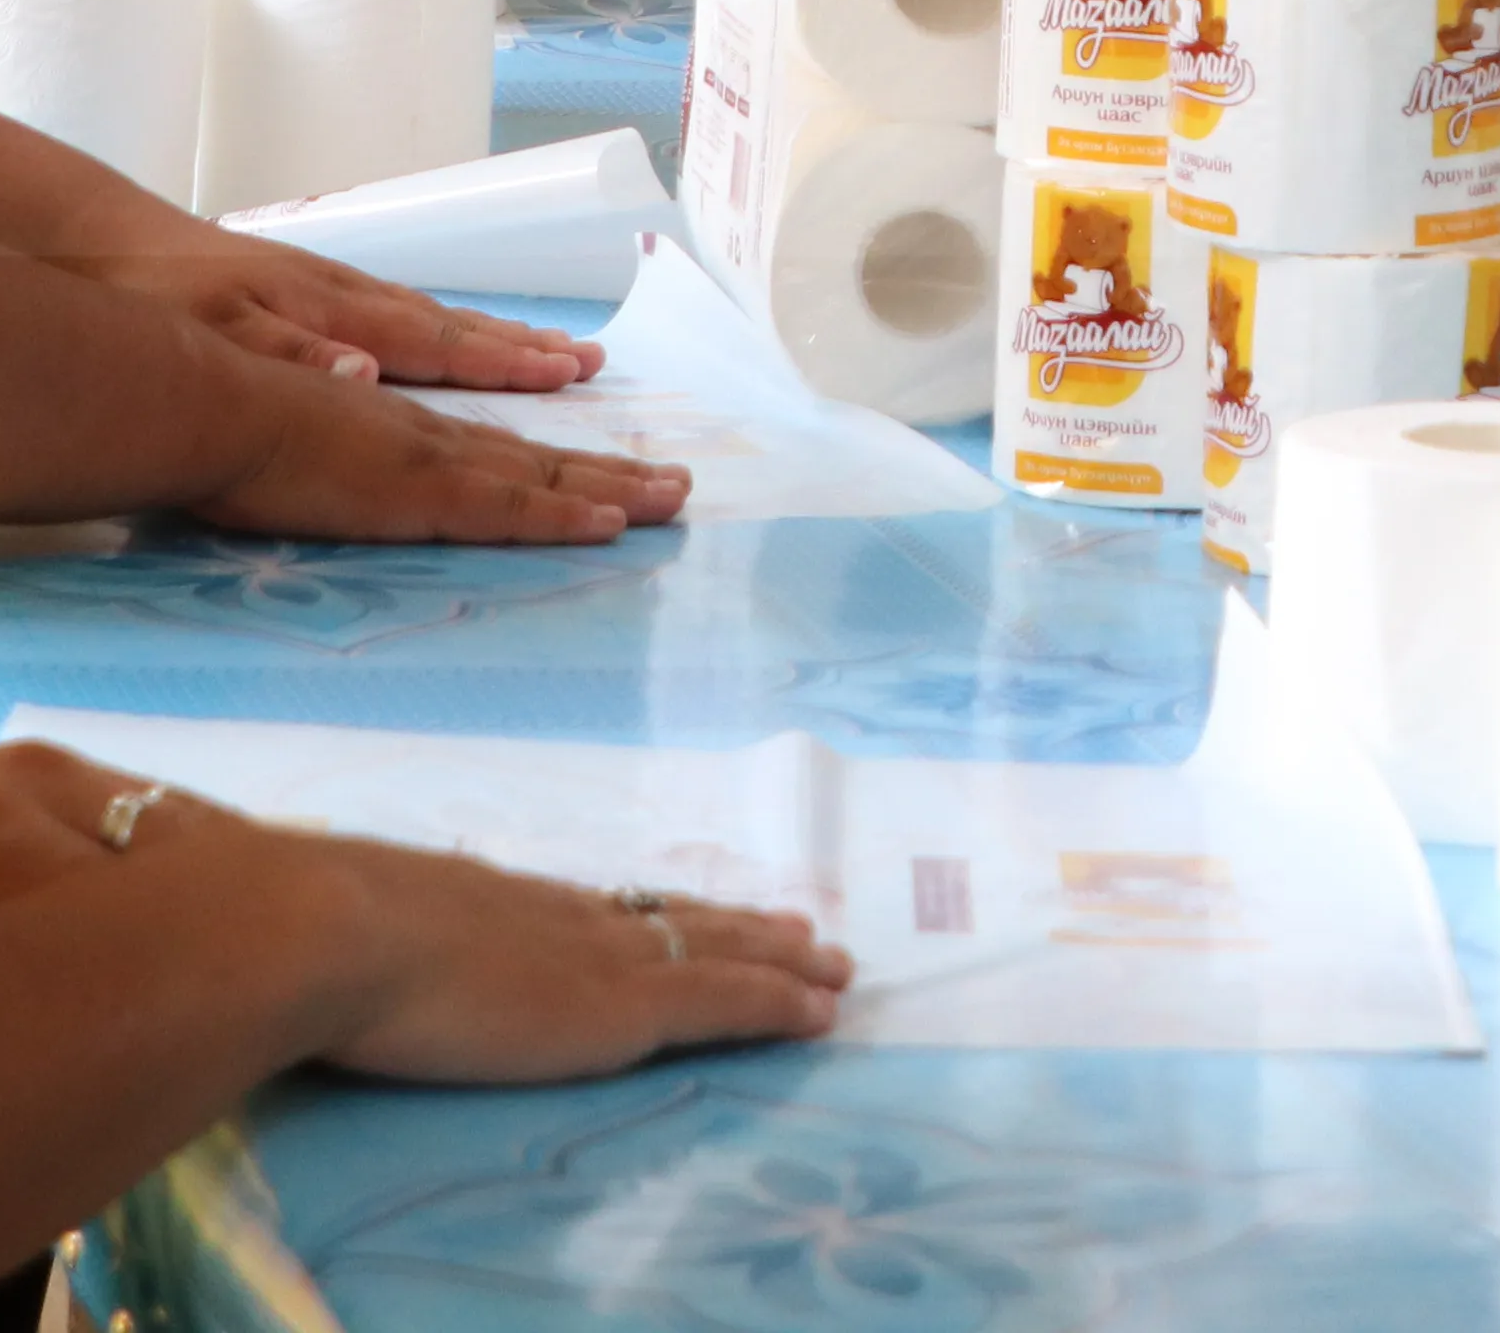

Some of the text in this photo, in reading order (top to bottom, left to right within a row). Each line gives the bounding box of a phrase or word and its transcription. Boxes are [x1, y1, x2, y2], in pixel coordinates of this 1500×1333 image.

[1051, 83, 1105, 107] Ариун
[1096, 107, 1143, 123] цаас
[1012, 306, 1185, 395] Мазаалай
[1021, 406, 1158, 438] Ариун цэврийн
